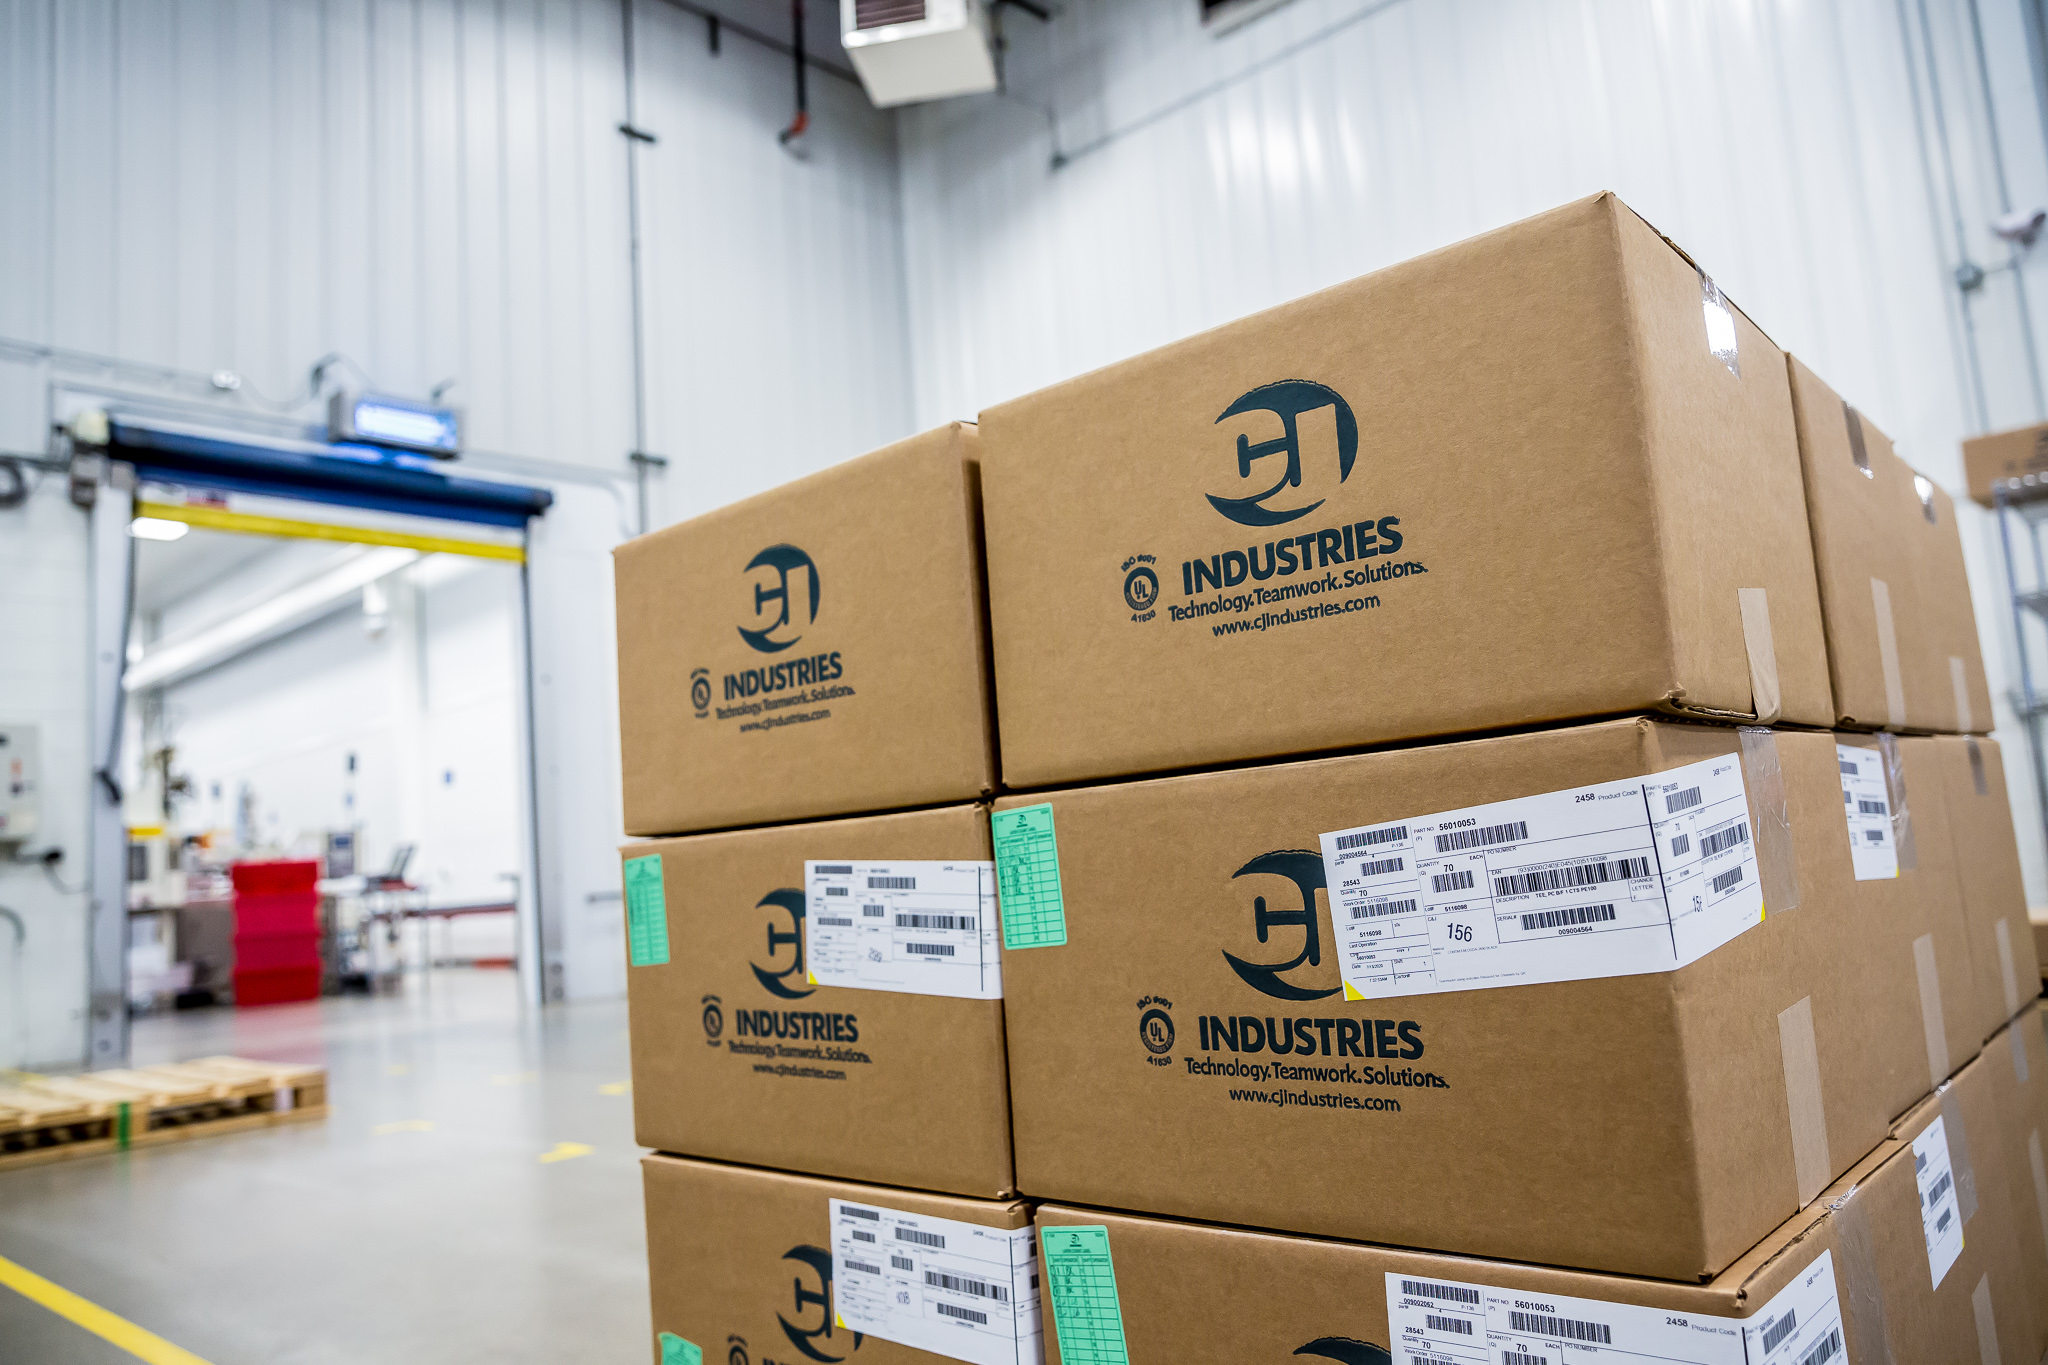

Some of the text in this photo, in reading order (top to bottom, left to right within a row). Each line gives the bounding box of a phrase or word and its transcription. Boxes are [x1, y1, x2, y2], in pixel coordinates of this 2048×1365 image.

[1182, 516, 1404, 595] INDUSTRIES
[1134, 580, 1149, 599] UL
[1212, 594, 1381, 637] www.cjindustries.com
[724, 651, 843, 700] INDUSTRIES
[1575, 789, 1638, 803] 2458 Product Code
[1439, 818, 1476, 831] 56010053
[1495, 846, 1517, 854] NUMBER
[1443, 864, 1454, 872] 70
[1342, 879, 1360, 887] 28543
[1496, 894, 1529, 904] DESCRIPTION
[1445, 904, 1467, 912] 5116098
[1447, 923, 1473, 942] 156
[1558, 926, 1593, 935] 009004564
[736, 1009, 859, 1043] INDUSTRIES
[1150, 1022, 1165, 1042] UL
[1198, 1016, 1425, 1060] INDUSTRIES
[1229, 1087, 1402, 1112] www.cjindustries.com
[1515, 1300, 1555, 1313] 56010053
[1405, 1326, 1424, 1335] 28543
[1666, 1317, 1736, 1336] 2458 Product Code
[1422, 1341, 1431, 1349] 70
[1516, 1343, 1527, 1352] 70
[1574, 1344, 1598, 1352] NUMBER
[1430, 1353, 1453, 1361] 5116098
